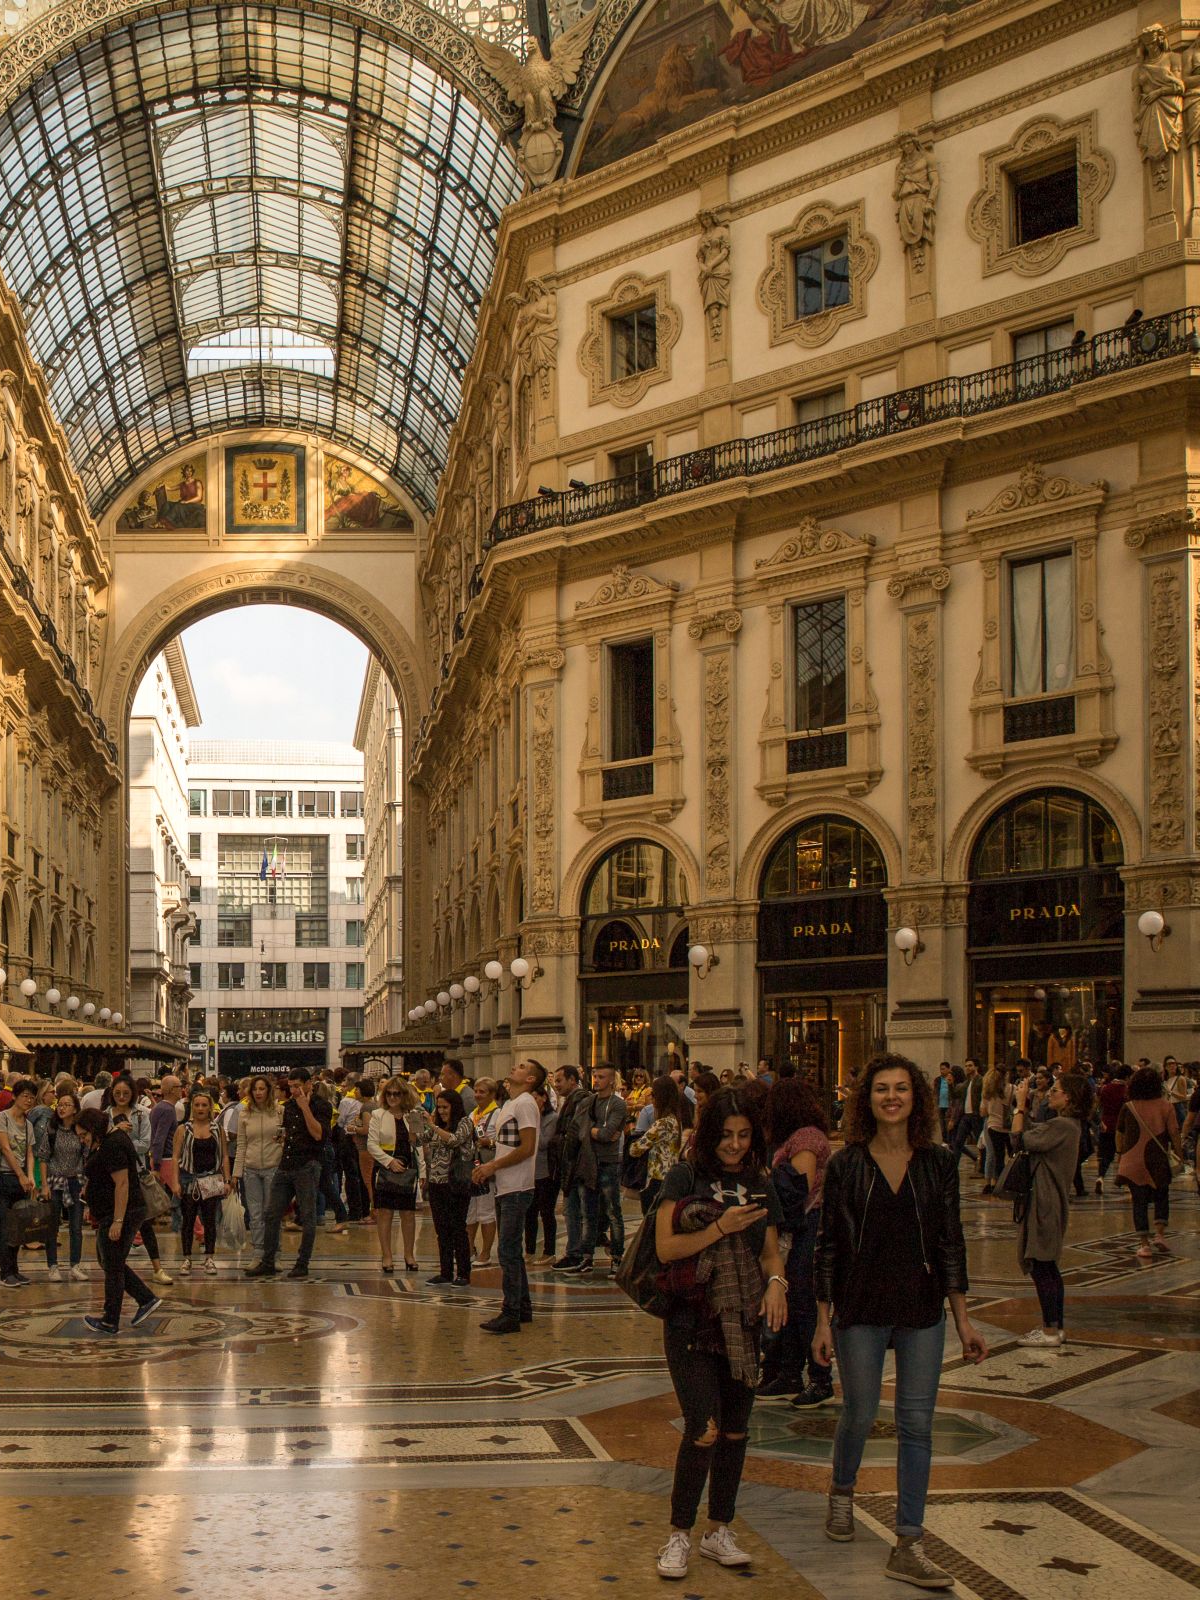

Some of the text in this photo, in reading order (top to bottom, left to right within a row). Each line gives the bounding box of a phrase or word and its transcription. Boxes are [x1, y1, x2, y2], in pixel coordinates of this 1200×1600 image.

[1010, 904, 1081, 921] PRADA
[793, 922, 853, 938] PRADA
[609, 937, 661, 952] PRADA
[250, 1065, 291, 1073] McDonald's
